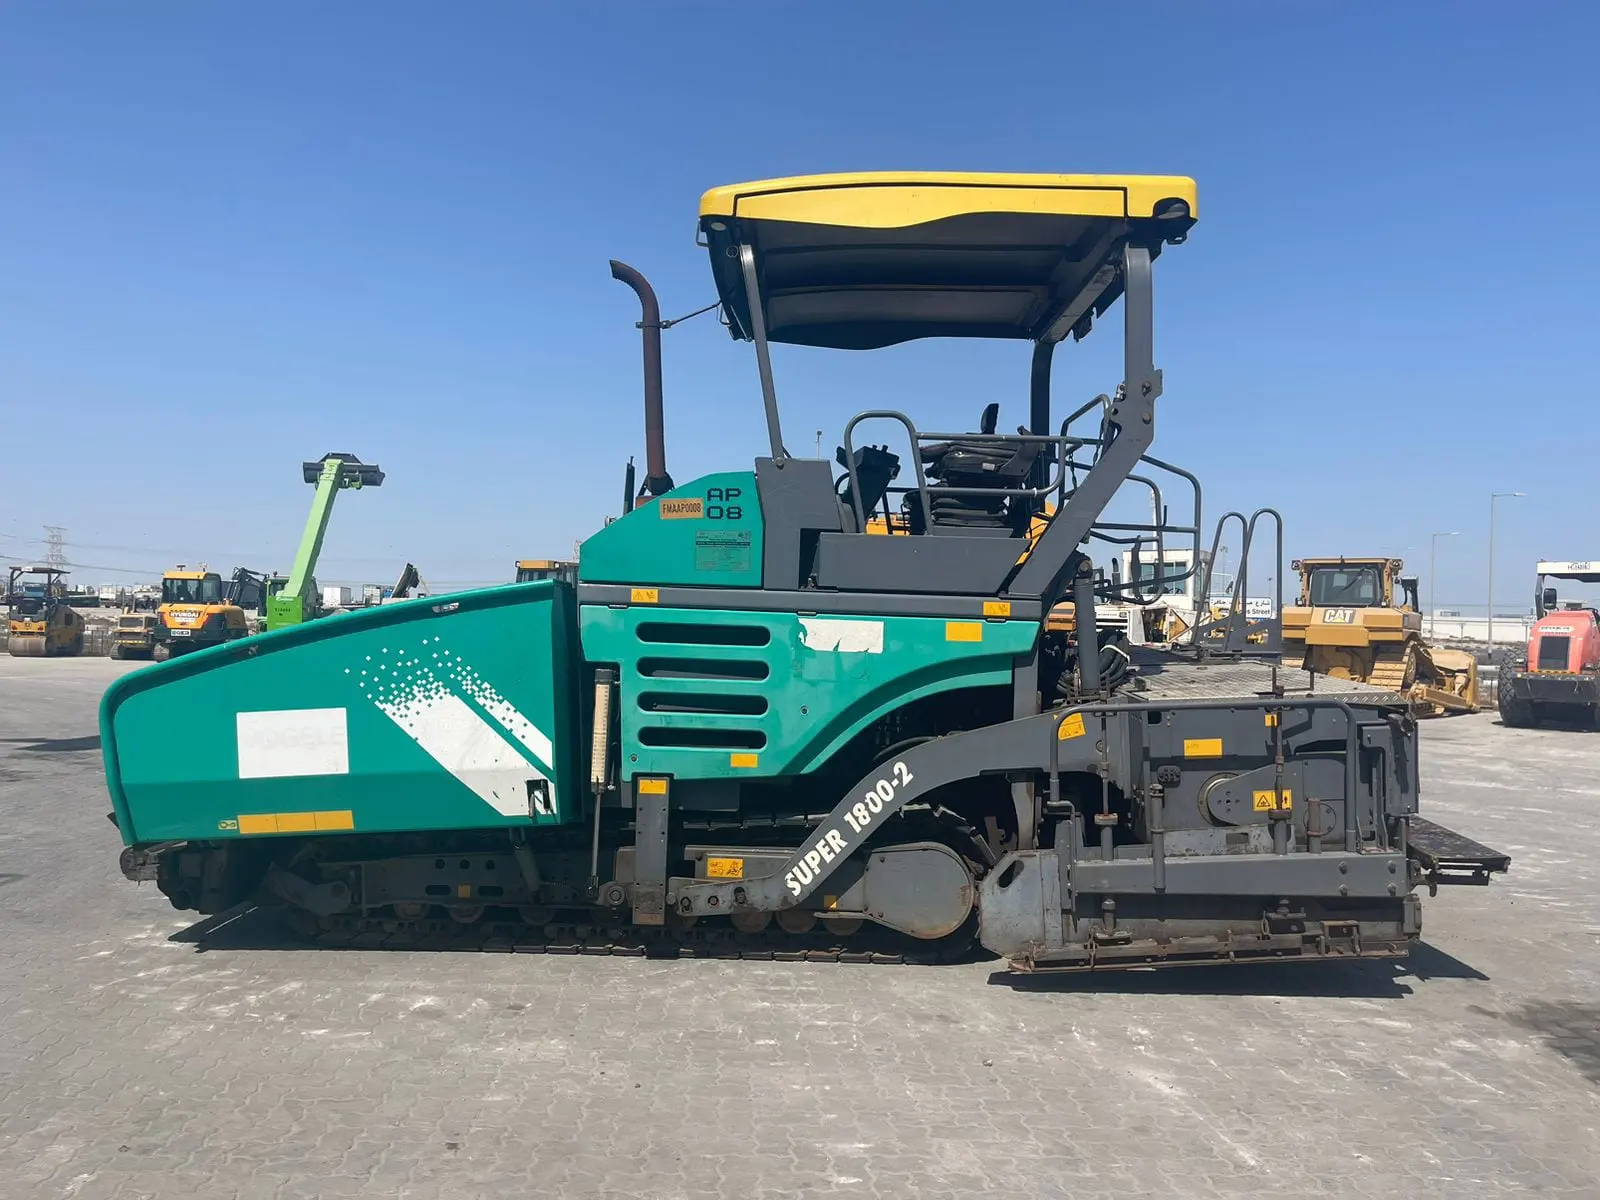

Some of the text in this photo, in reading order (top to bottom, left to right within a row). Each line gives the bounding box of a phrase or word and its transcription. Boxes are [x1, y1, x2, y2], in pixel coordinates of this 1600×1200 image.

[707, 487, 742, 502] AP
[1324, 609, 1354, 623] CAT
[784, 761, 914, 897] SUPER 1800-2
